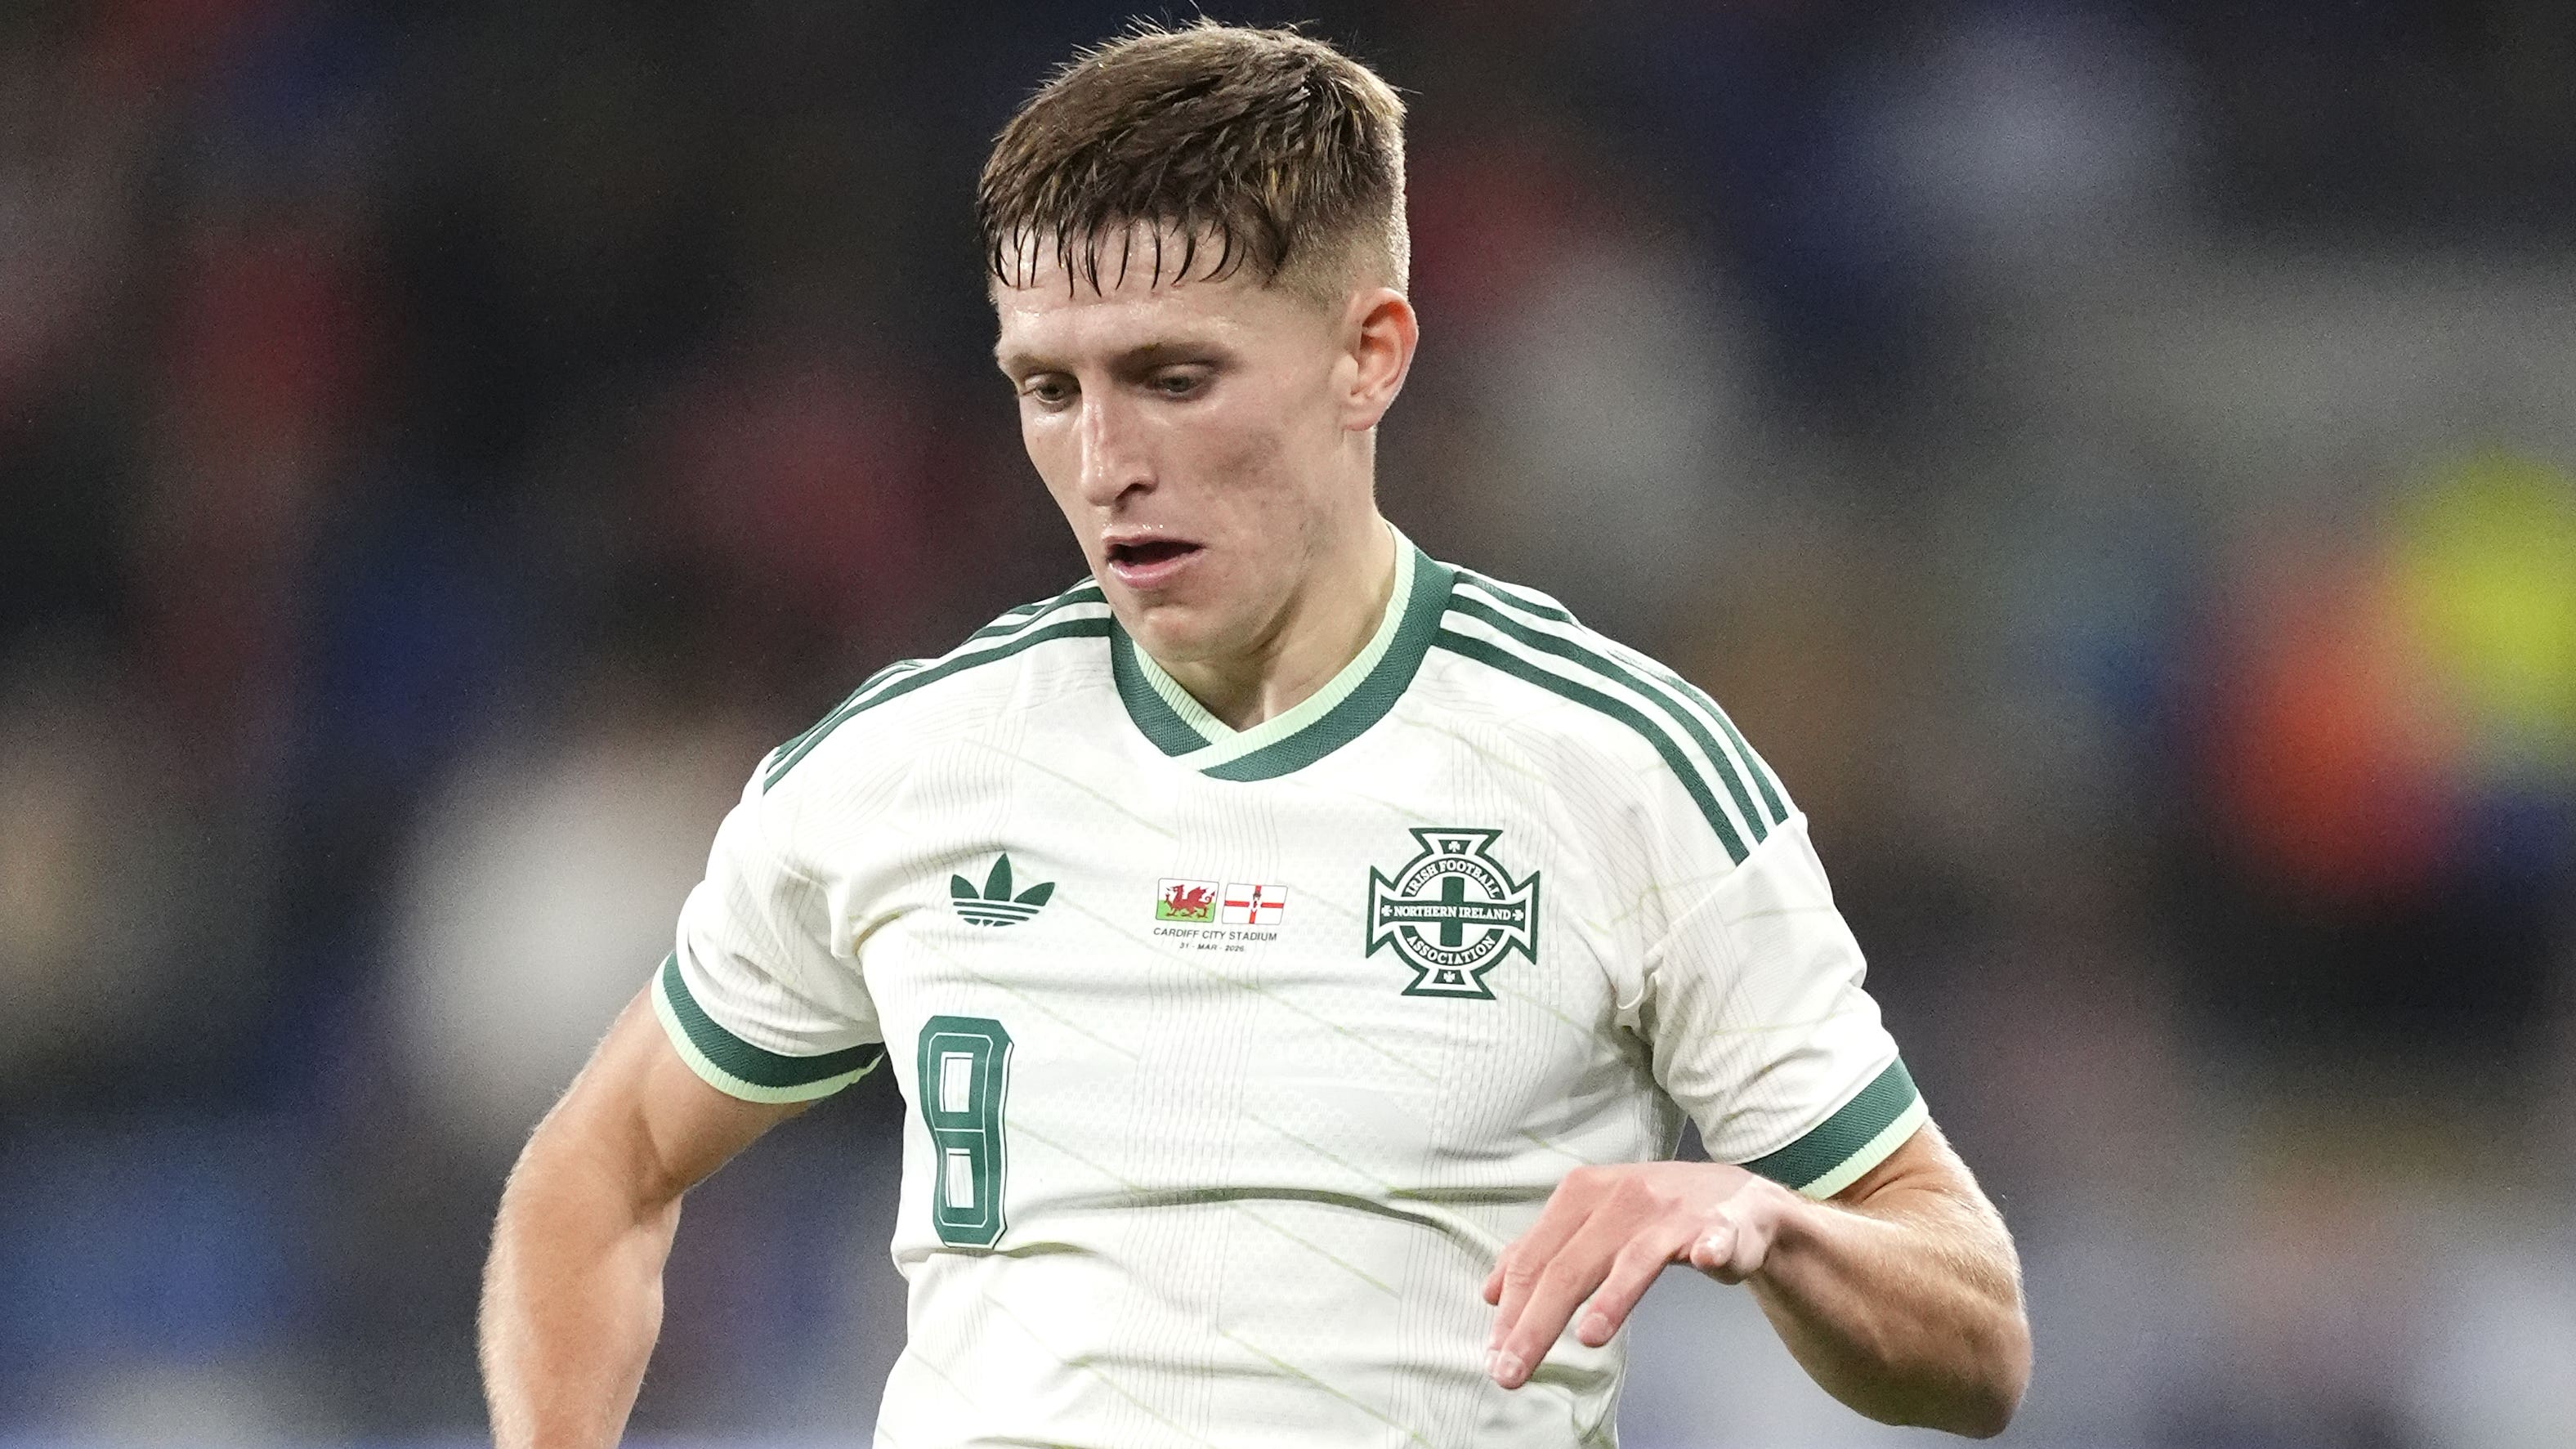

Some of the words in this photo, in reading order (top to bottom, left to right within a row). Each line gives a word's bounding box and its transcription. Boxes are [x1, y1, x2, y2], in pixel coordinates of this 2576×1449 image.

[1405, 862, 1438, 896] IRISH
[1438, 860, 1500, 898] FOOTBALL
[1393, 906, 1457, 918] NORTHERN
[1458, 907, 1511, 920] IRELAND
[1153, 928, 1199, 938] CARDIFF
[1202, 930, 1226, 939] CITY
[1229, 932, 1277, 941] STADIUM
[1407, 935, 1496, 964] ASSOCIATION
[917, 1015, 1014, 1249] 8
